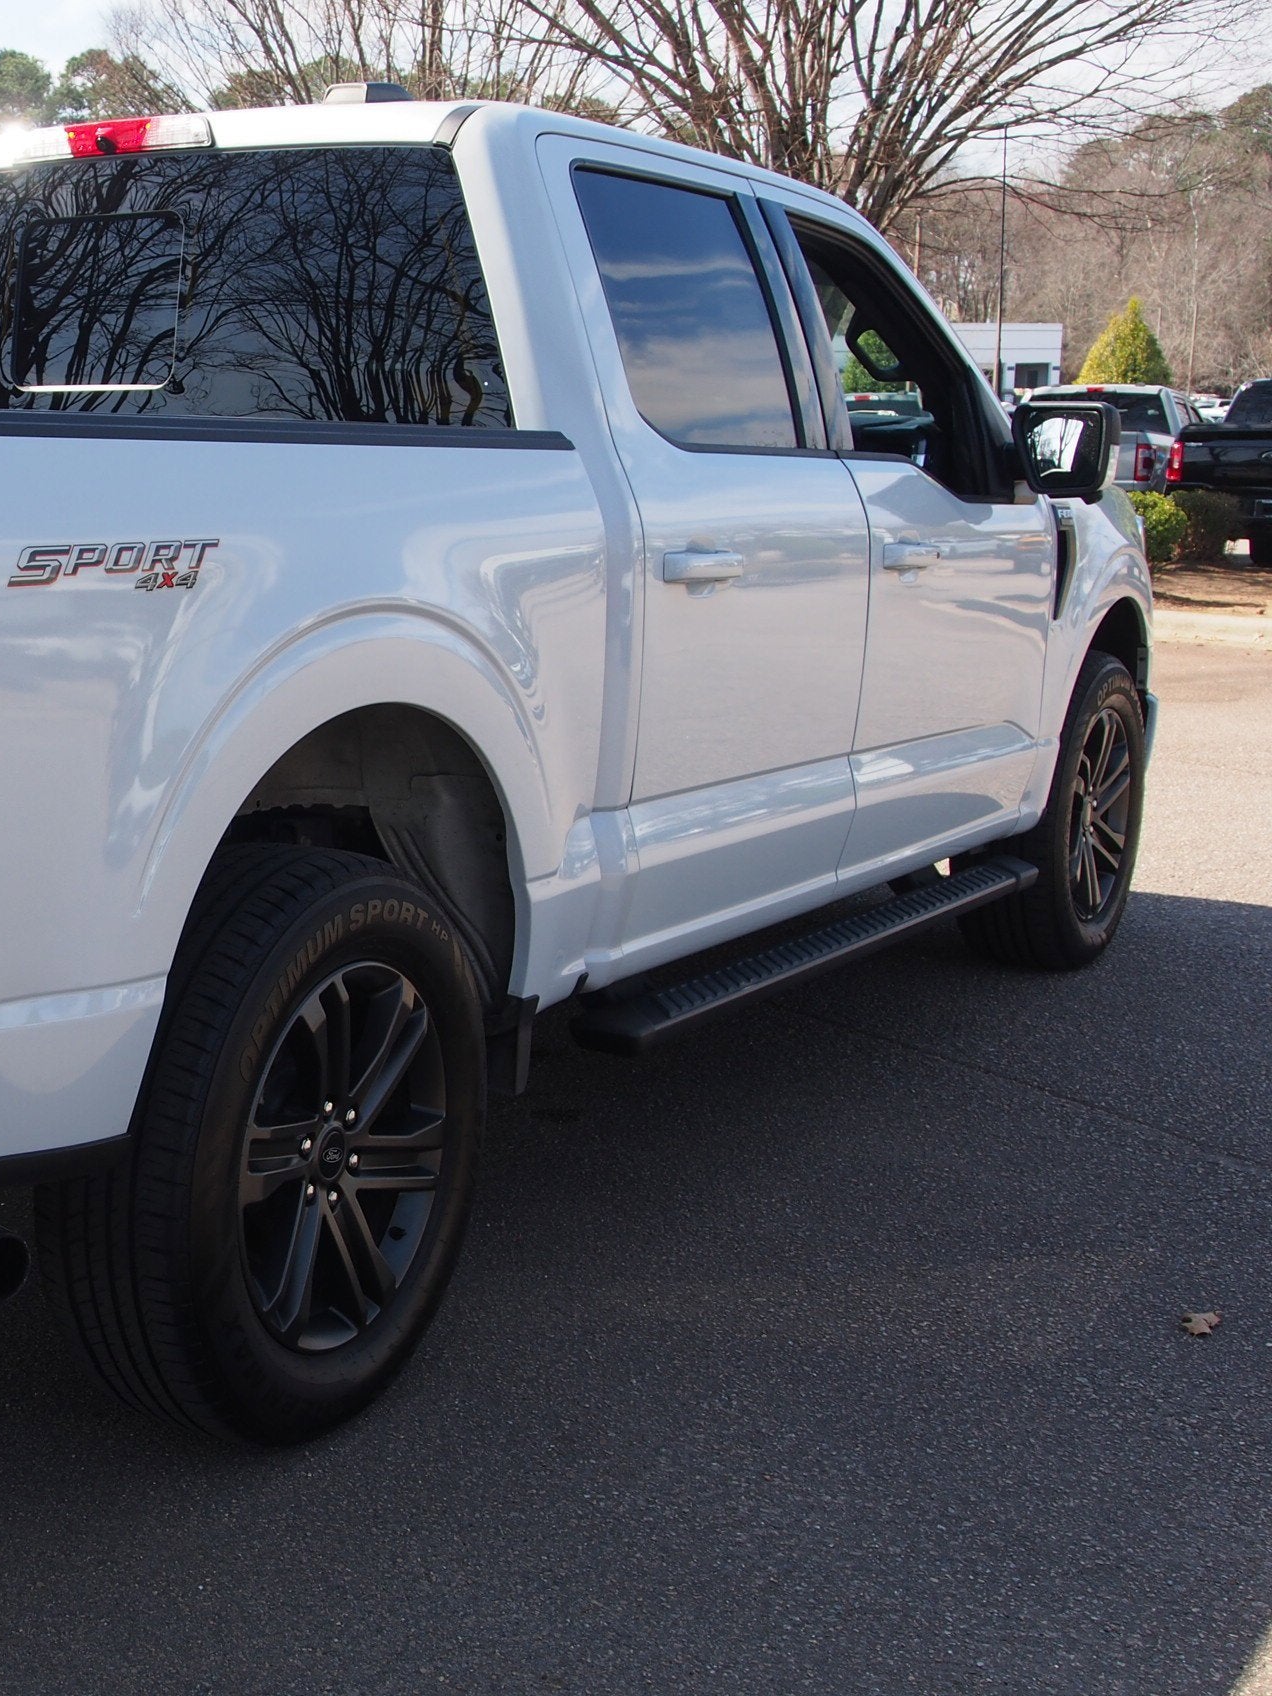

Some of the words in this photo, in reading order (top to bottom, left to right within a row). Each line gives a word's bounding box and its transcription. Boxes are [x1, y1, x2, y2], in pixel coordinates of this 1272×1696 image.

[7, 539, 219, 588] SPORT
[239, 914, 344, 1083] OPTIMUM
[349, 898, 429, 932] SPORT
[431, 919, 449, 943] HP
